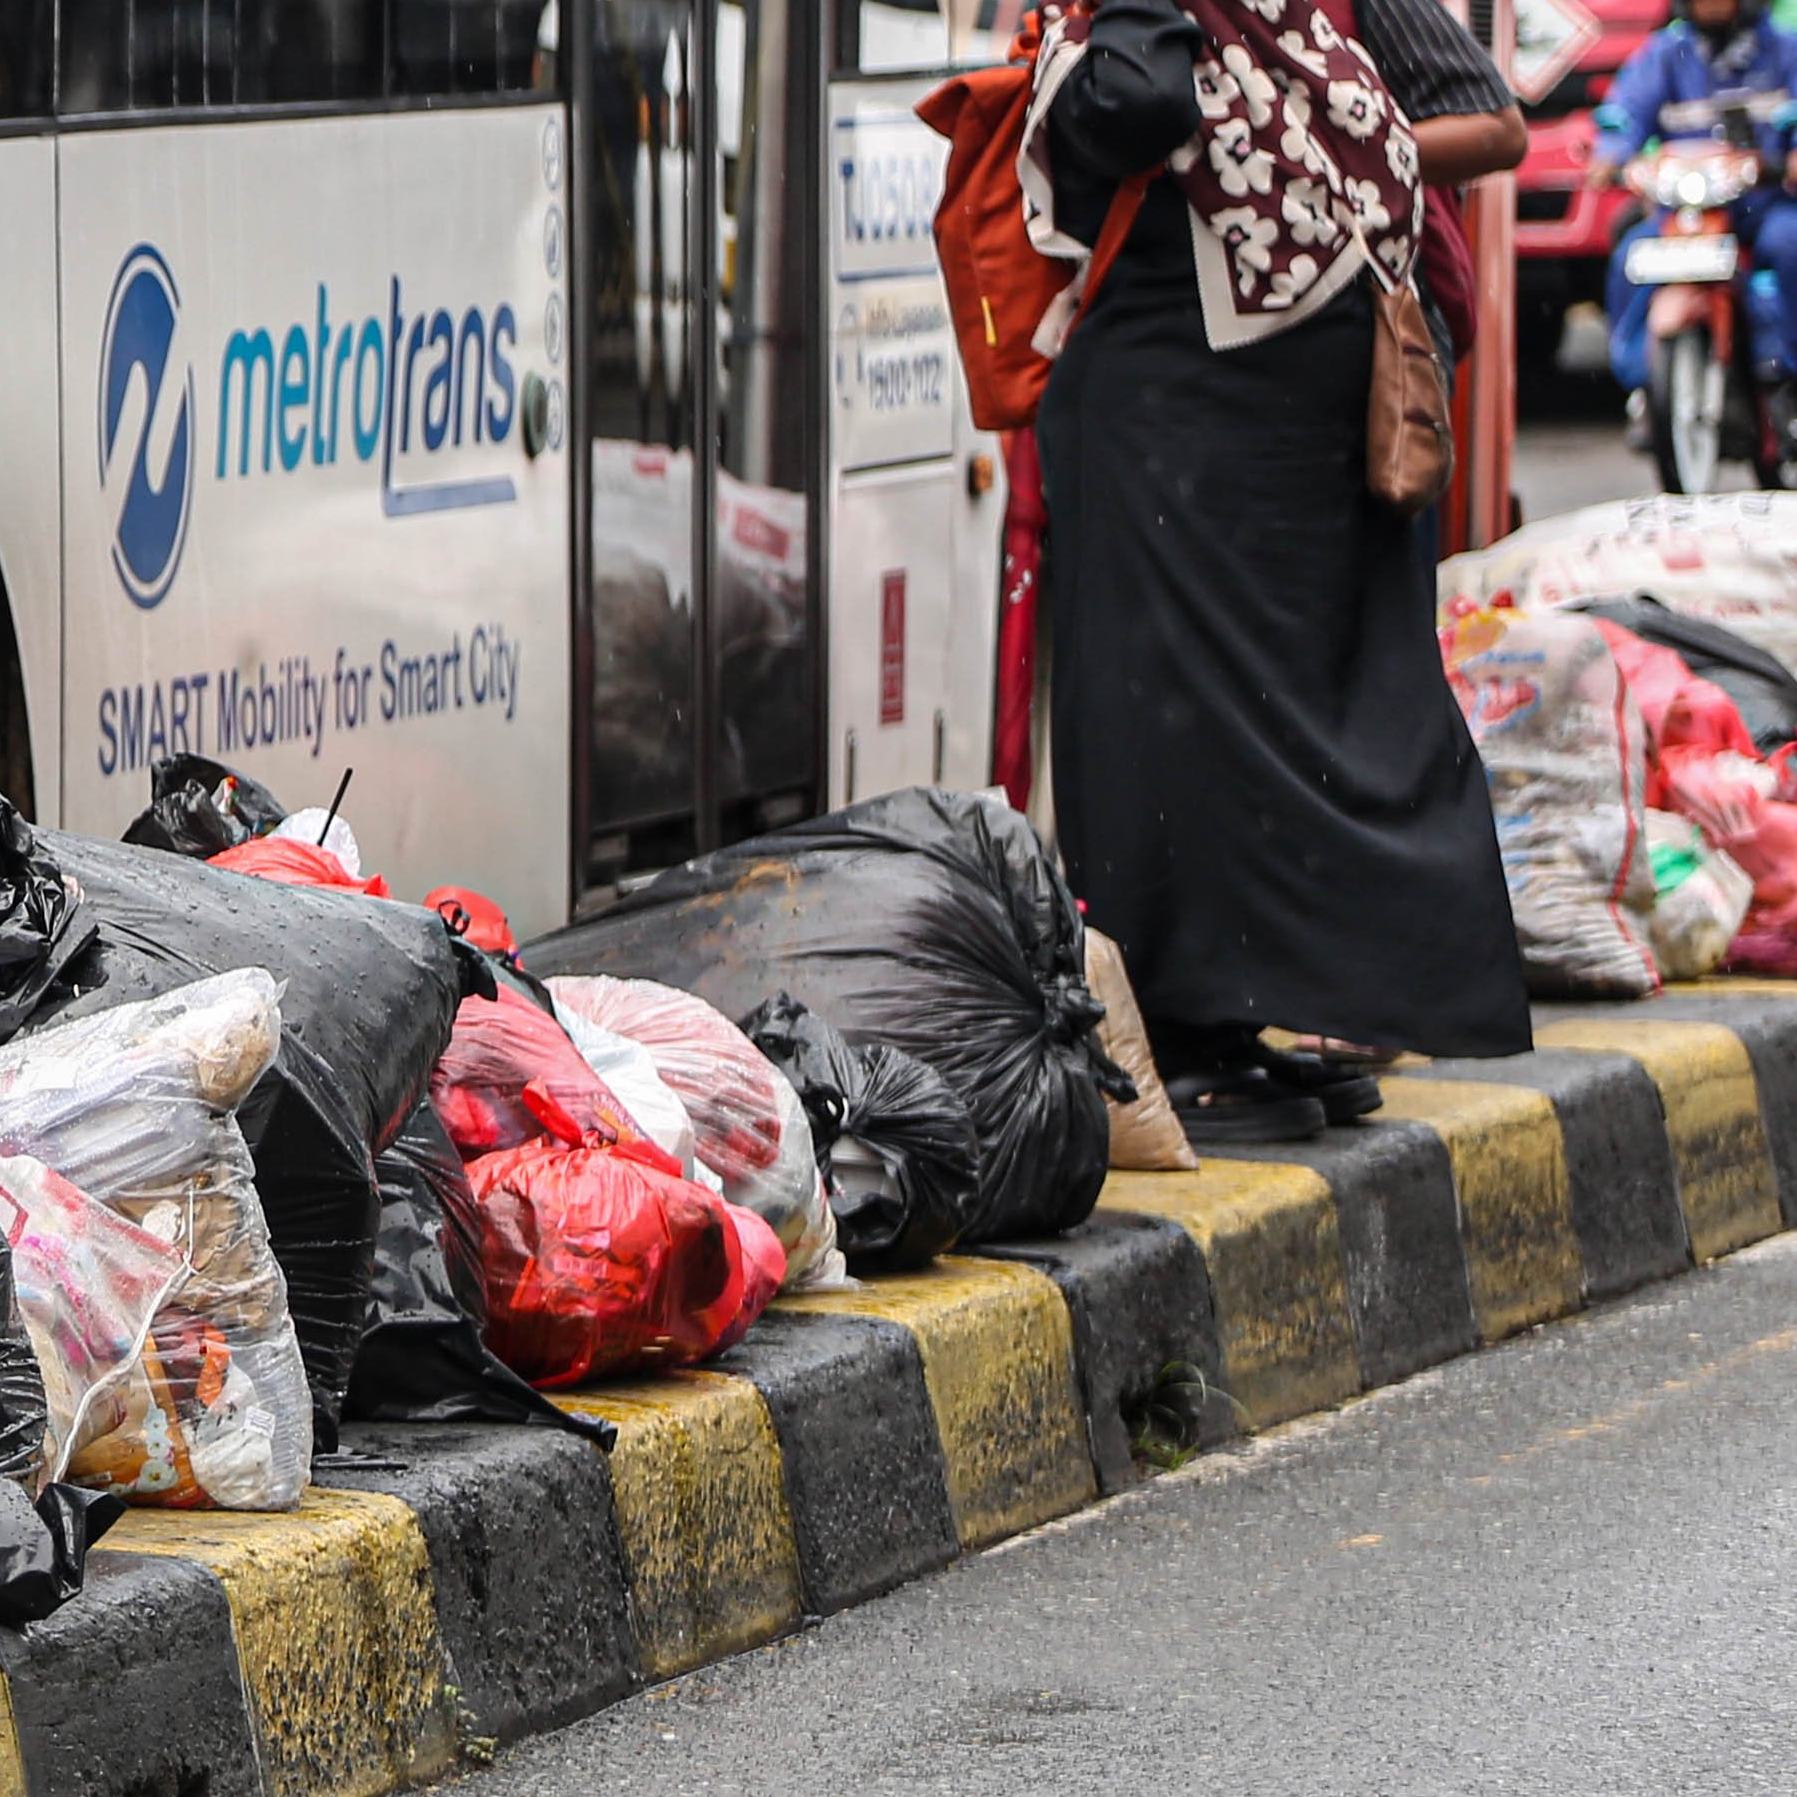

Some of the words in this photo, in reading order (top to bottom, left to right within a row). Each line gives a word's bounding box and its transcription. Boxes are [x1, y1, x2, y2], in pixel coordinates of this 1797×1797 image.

[216, 272, 516, 486] metrotrans
[98, 671, 210, 776] SMART
[217, 651, 327, 758] Mobility
[333, 646, 373, 730] for
[380, 630, 463, 722] Smart
[468, 622, 521, 723] City
